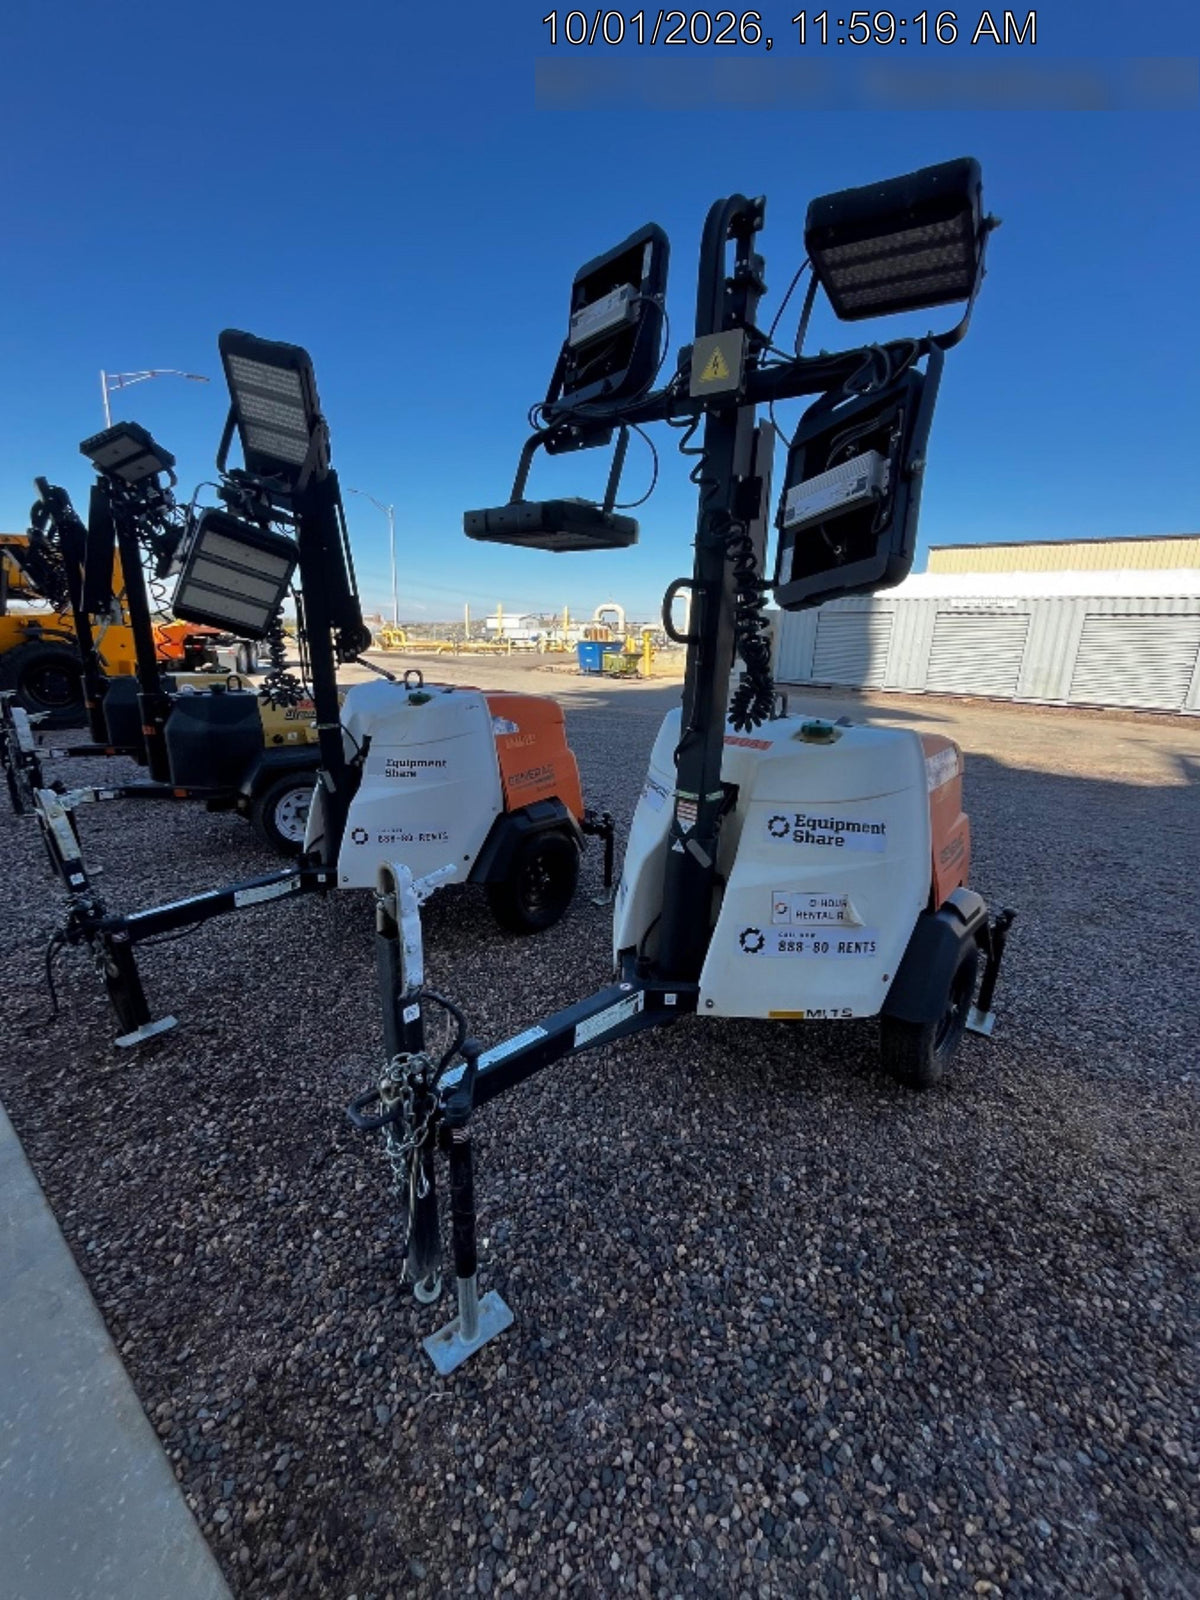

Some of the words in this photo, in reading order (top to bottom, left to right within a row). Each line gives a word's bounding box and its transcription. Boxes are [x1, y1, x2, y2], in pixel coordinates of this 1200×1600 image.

[385, 758, 447, 768] Equipment
[385, 768, 417, 778] Share
[795, 813, 886, 835] Equipment
[793, 829, 845, 847] Share
